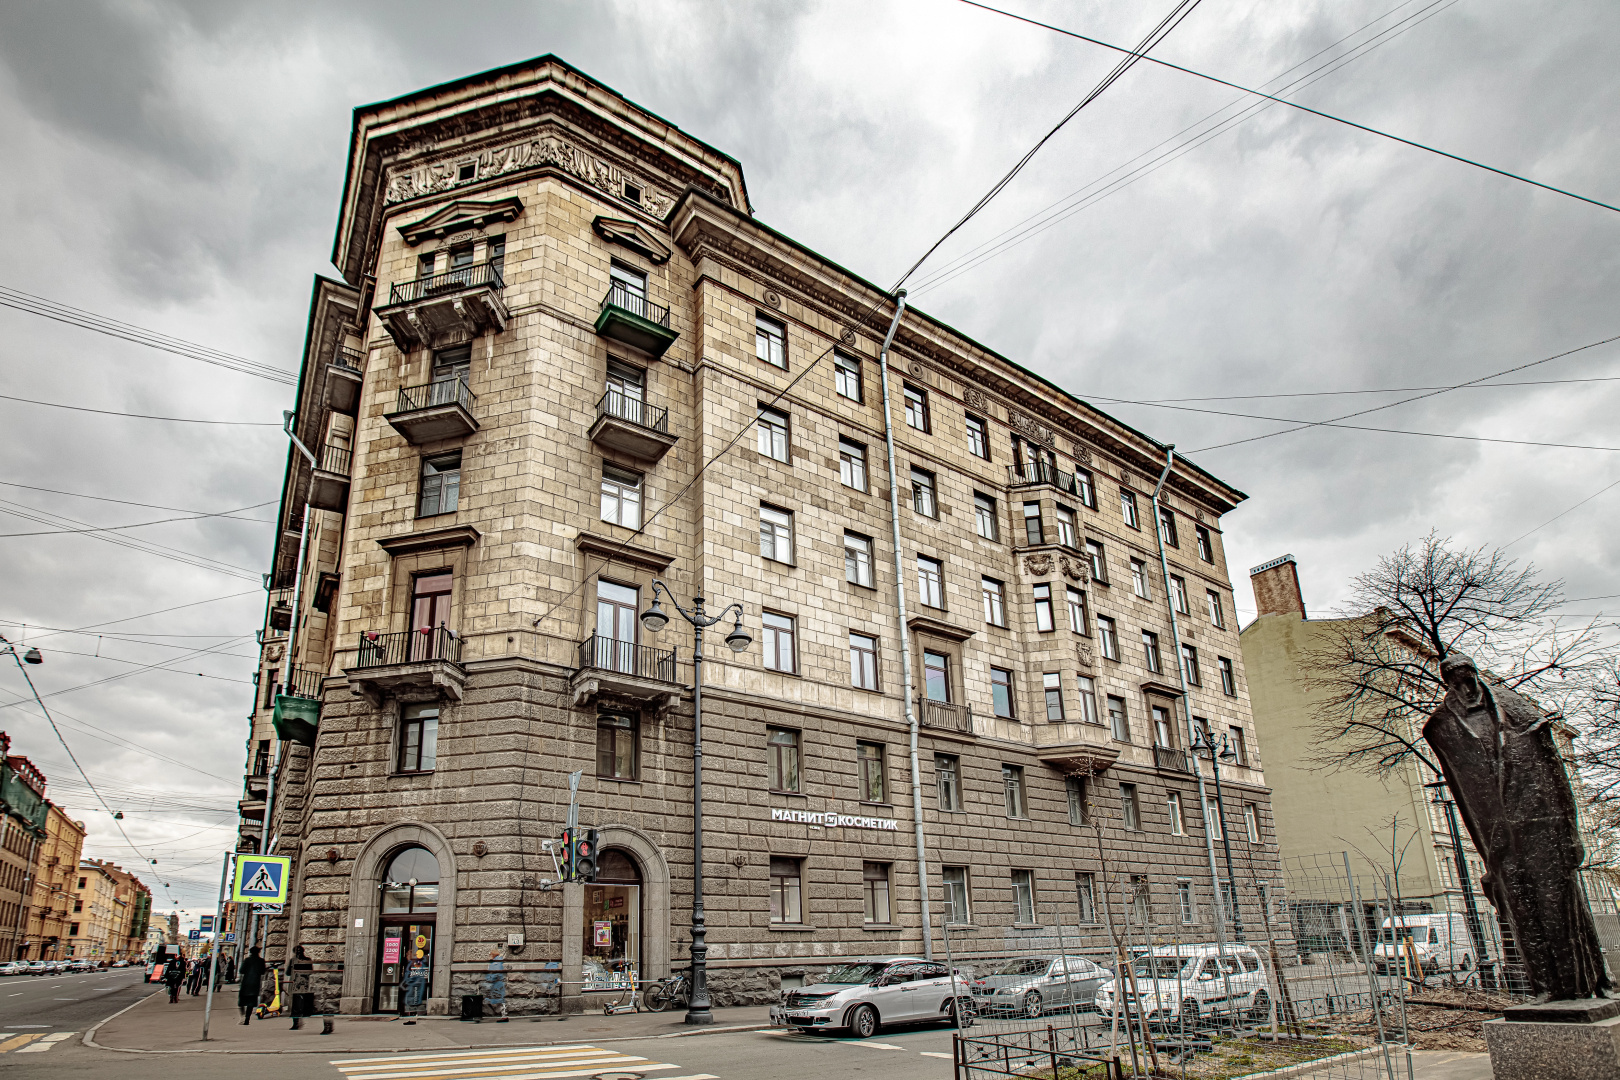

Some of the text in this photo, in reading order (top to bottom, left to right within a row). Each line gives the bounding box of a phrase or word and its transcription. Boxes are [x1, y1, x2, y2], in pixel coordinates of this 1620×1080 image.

[771, 809, 898, 830] МАГНИТ КОСМЕТИК
[191, 931, 199, 939] P
